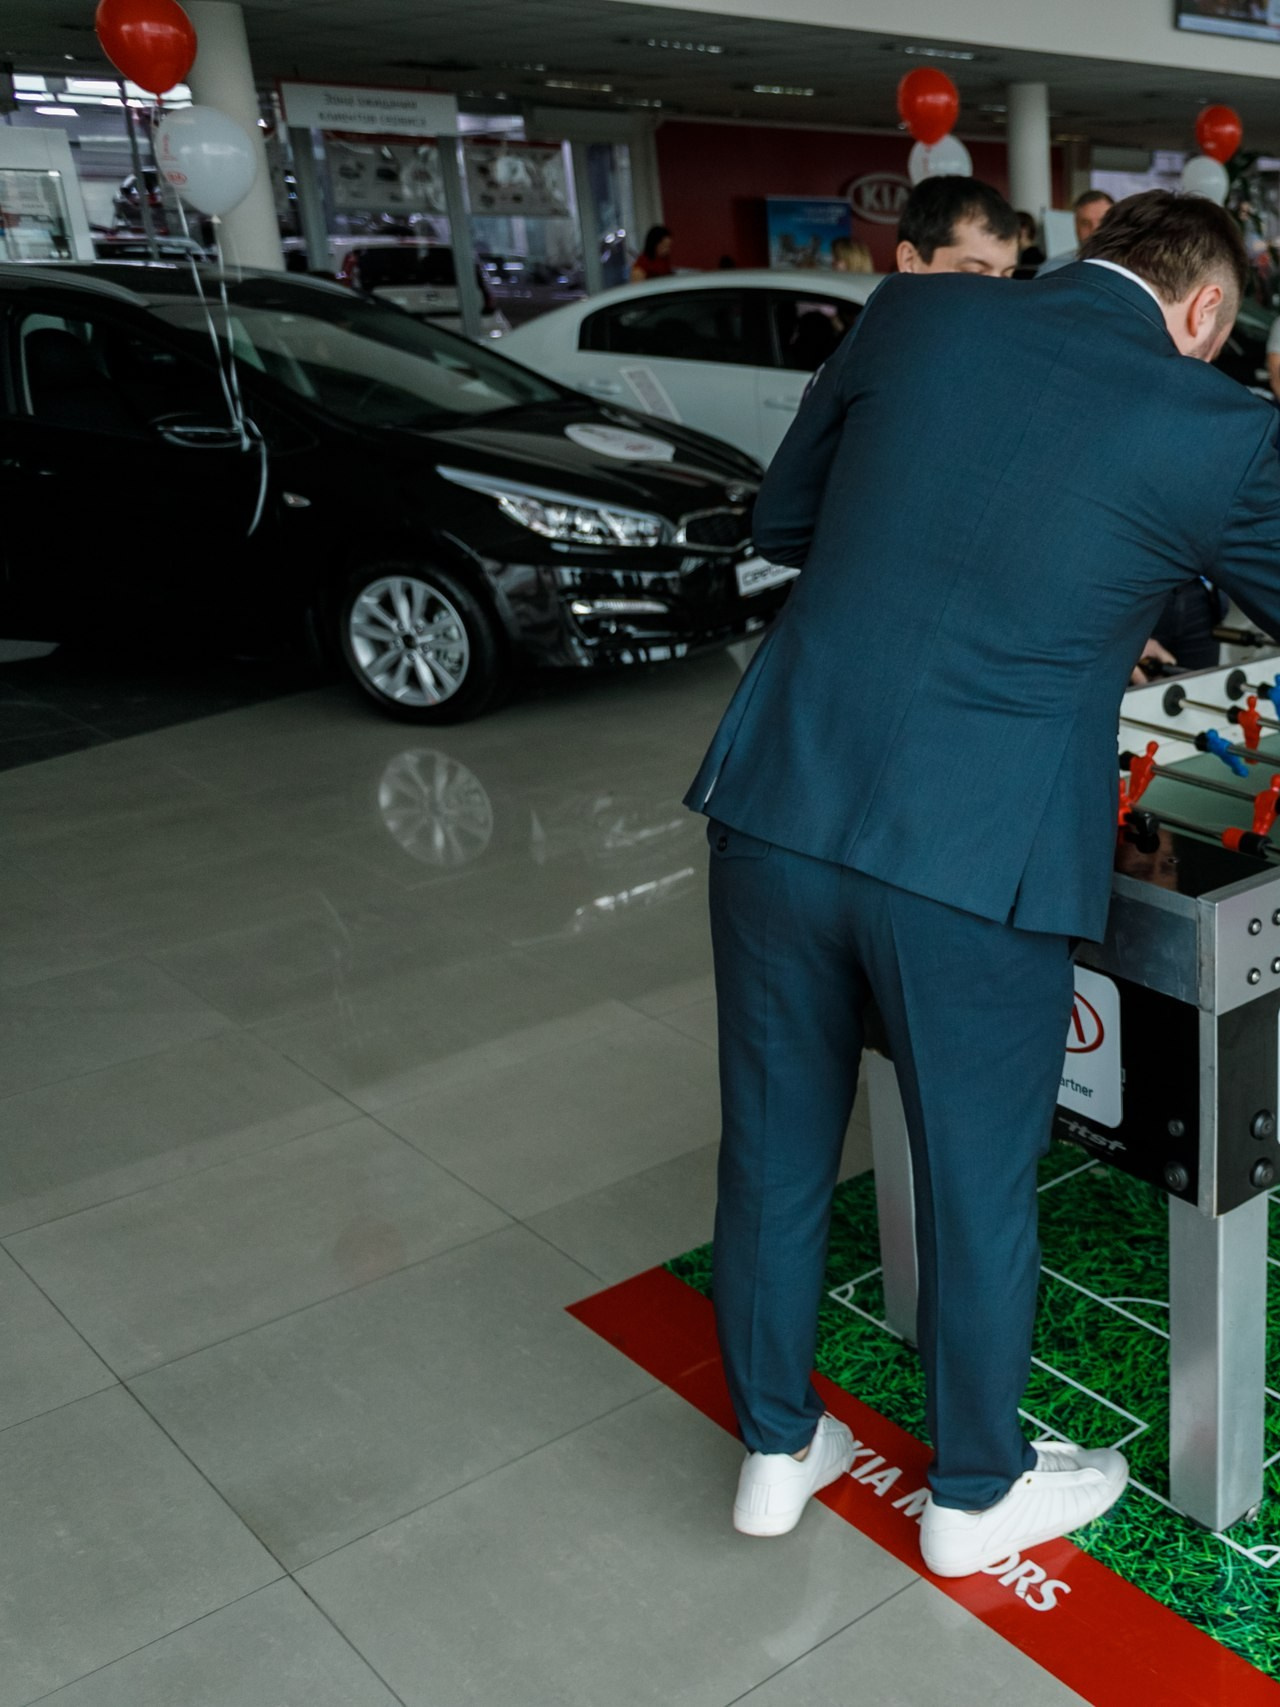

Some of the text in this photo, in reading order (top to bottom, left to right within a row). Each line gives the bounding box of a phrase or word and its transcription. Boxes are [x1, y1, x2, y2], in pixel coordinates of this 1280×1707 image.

[1059, 1076, 1094, 1098] artner
[850, 1440, 1072, 1611] KIA MORS
